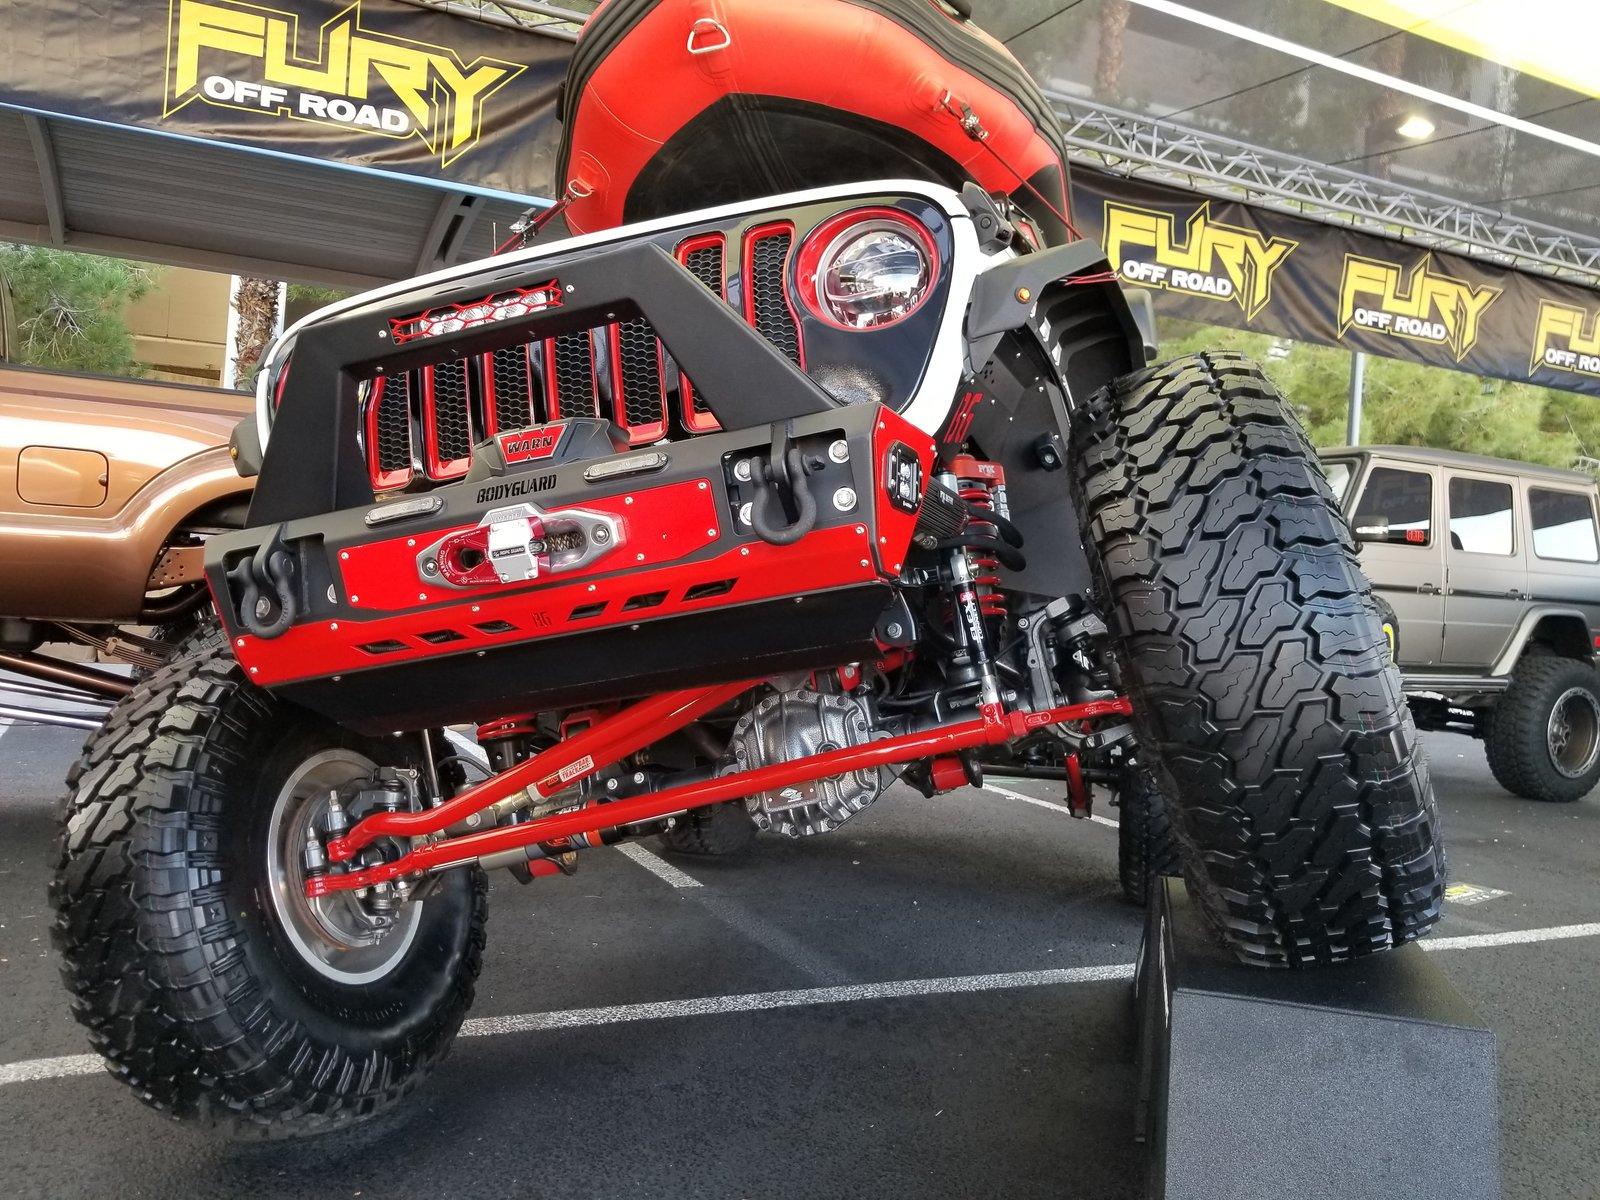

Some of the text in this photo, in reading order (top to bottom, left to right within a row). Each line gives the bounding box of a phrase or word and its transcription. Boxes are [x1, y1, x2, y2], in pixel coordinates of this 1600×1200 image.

[174, 0, 508, 150] FURY
[203, 75, 410, 132] OFF ROAD
[1107, 207, 1287, 307] FURY
[1122, 259, 1232, 296] OFF ROAD
[1341, 259, 1494, 350] FURY
[1354, 307, 1447, 340] OFF ROAD
[1533, 304, 1600, 365] FU
[1545, 347, 1600, 373] OFF RO
[507, 435, 553, 454] WARN
[476, 474, 557, 504] BODYGUARD
